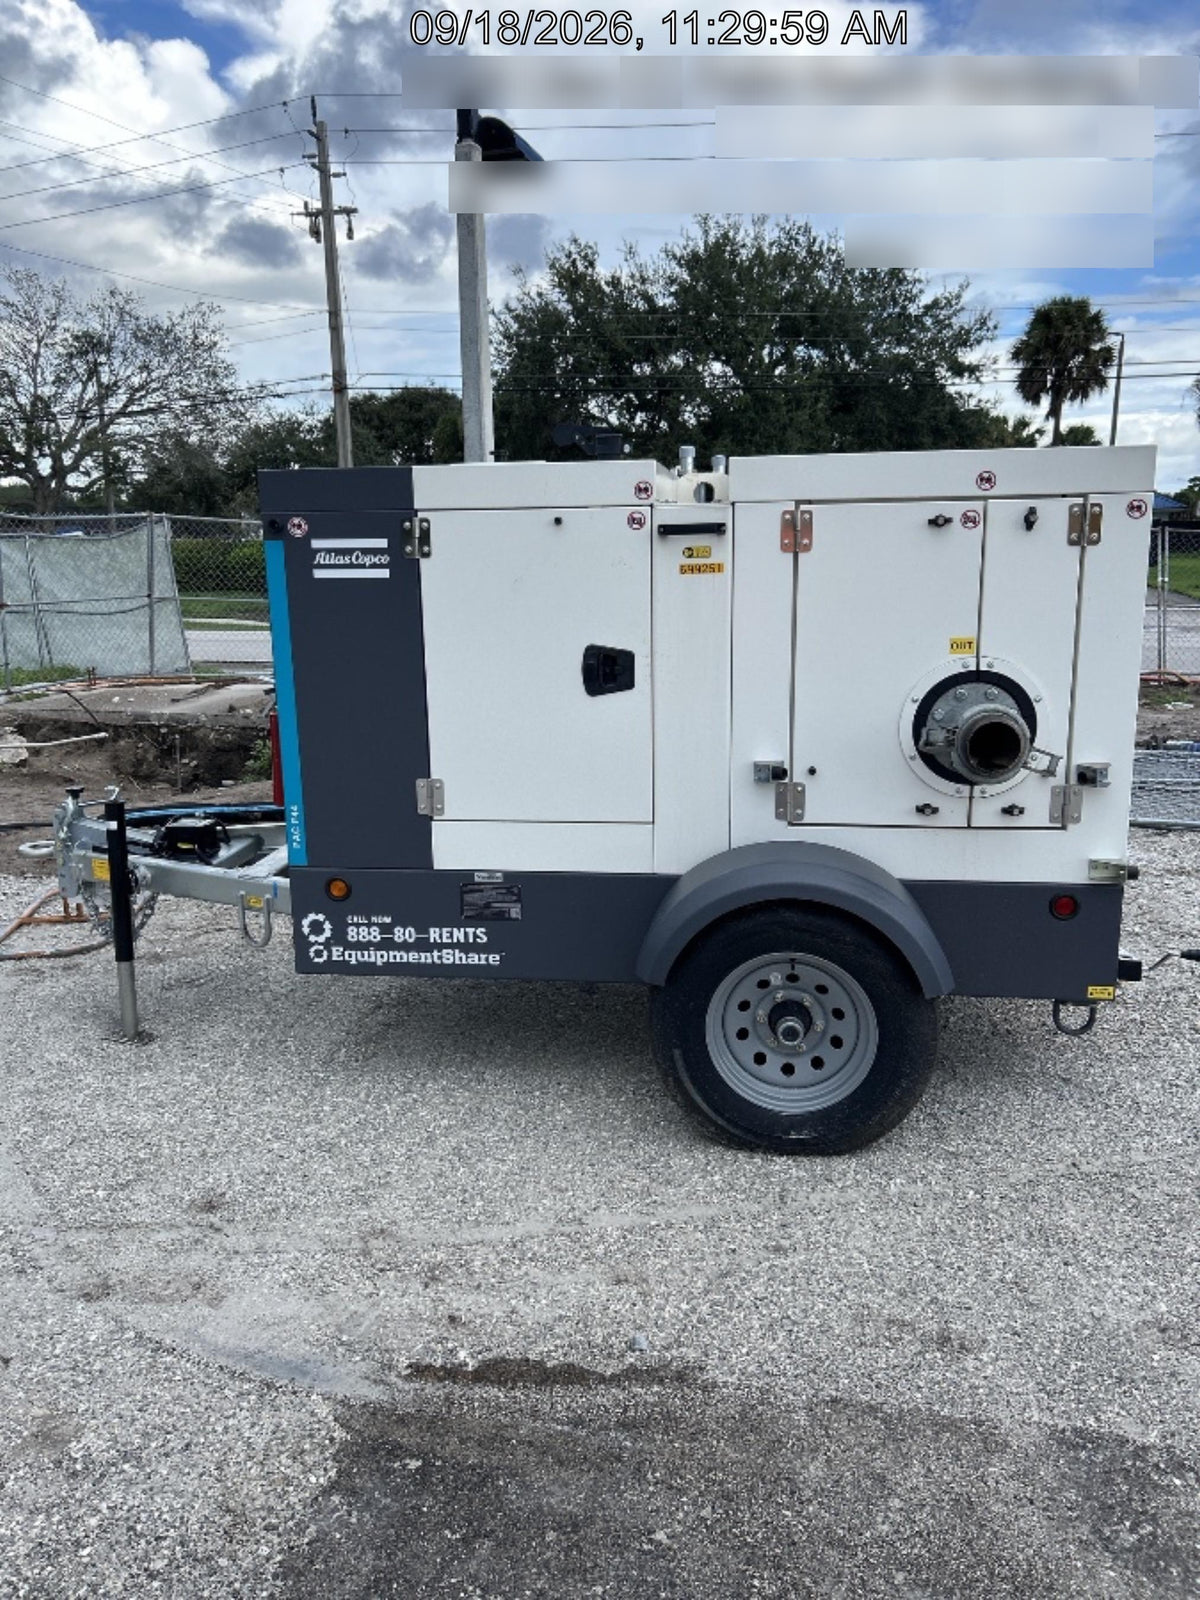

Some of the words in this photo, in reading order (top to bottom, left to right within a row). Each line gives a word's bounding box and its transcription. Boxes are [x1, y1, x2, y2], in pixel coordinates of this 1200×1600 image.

[950, 641, 974, 651] OUT
[347, 915, 369, 924] CALL
[371, 915, 392, 924] NOW
[346, 926, 489, 944] 888-80-RENTS
[331, 946, 501, 966] EquipmentShare
